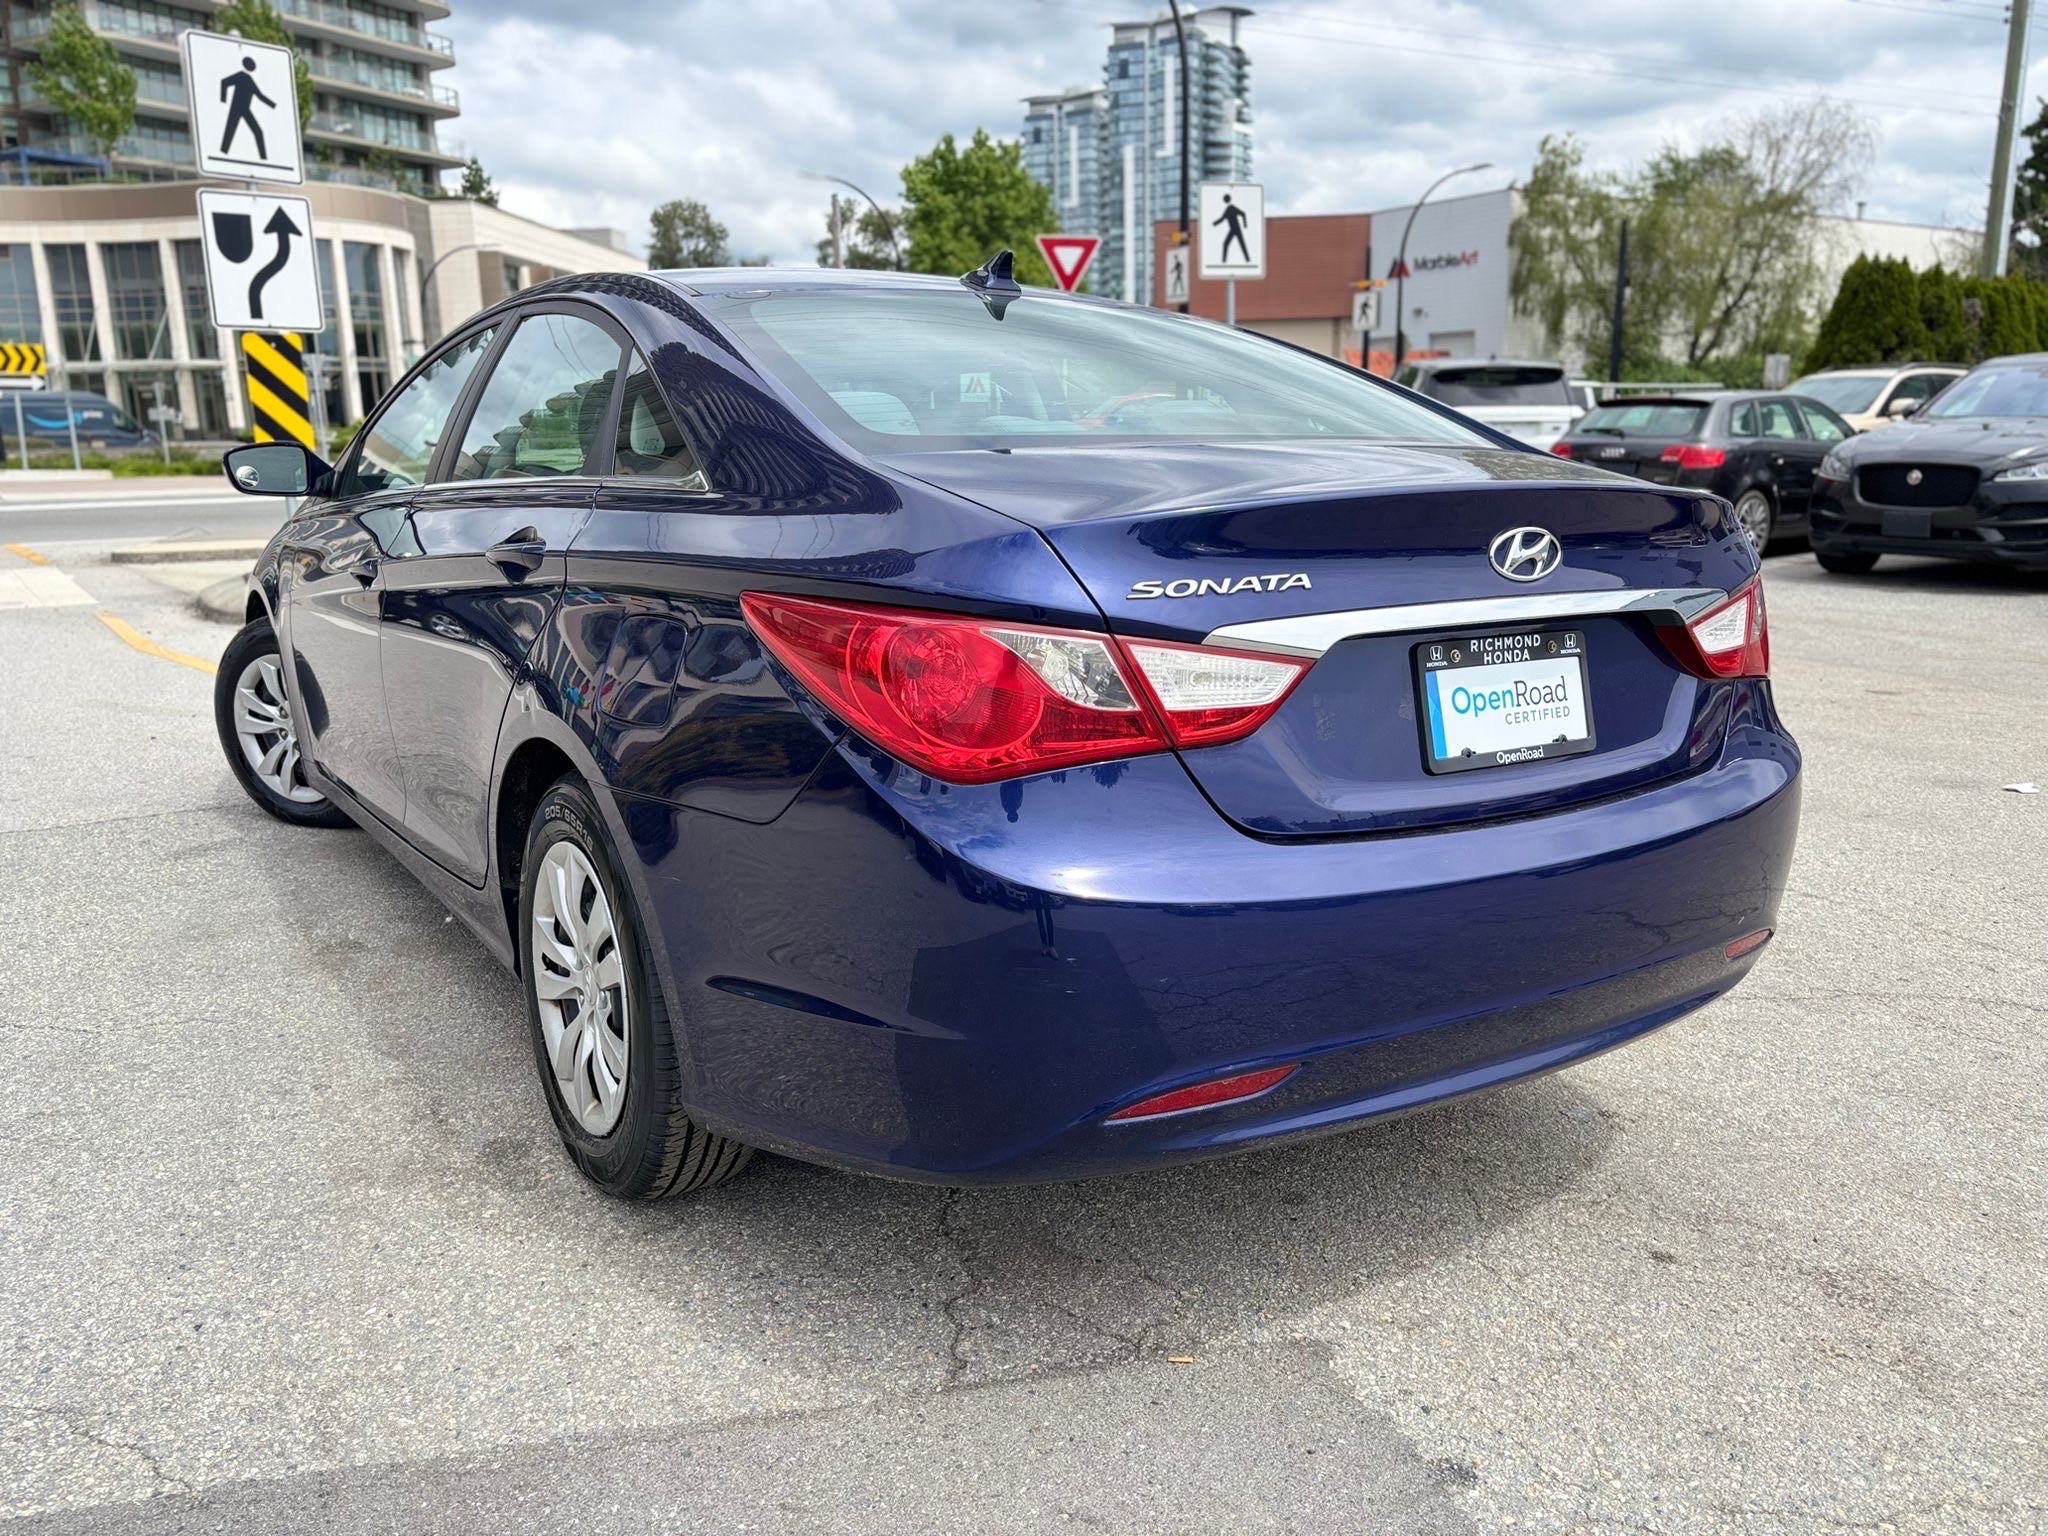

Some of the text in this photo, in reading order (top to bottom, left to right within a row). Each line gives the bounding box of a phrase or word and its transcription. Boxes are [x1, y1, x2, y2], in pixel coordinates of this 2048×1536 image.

[1126, 573, 1312, 600] SONATA
[1470, 634, 1541, 652] RICHMOND
[1560, 647, 1581, 655] HONDA
[1426, 660, 1448, 668] HONDA
[1483, 648, 1531, 665] HONDA
[1451, 675, 1568, 718] OpenRoad
[1504, 705, 1571, 725] CERTIFIED
[1496, 746, 1544, 765] OpenRoad
